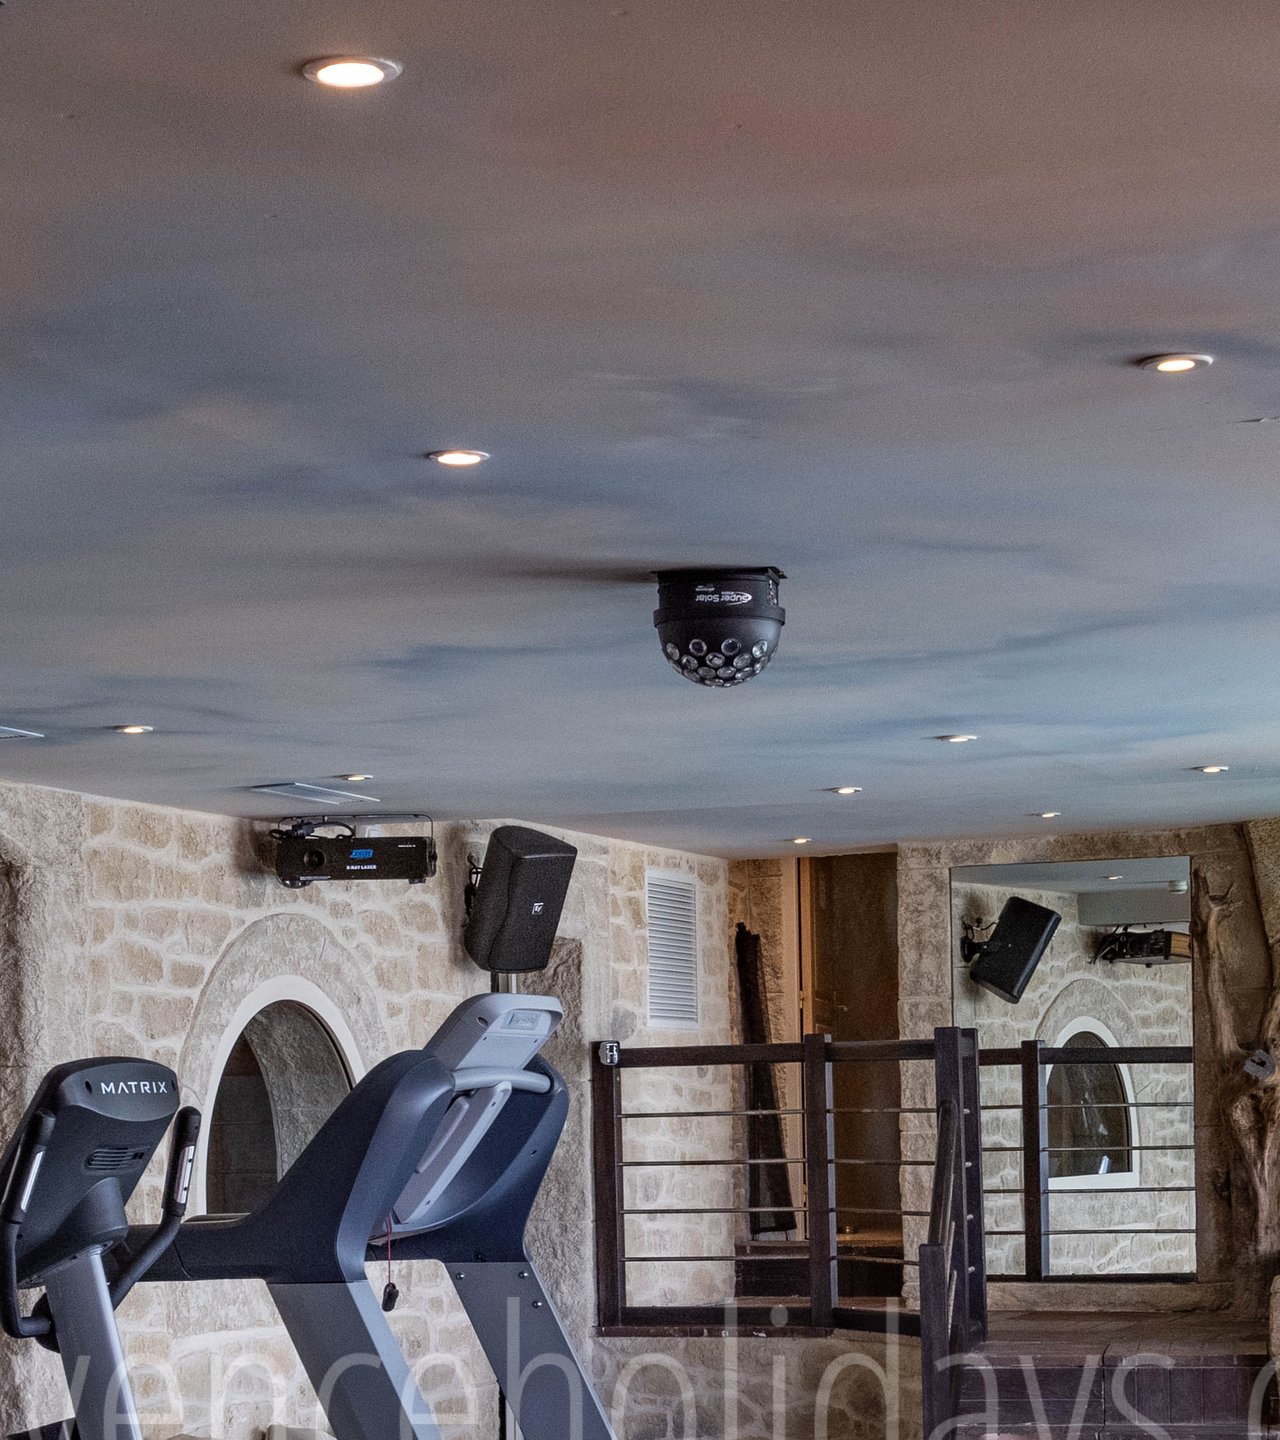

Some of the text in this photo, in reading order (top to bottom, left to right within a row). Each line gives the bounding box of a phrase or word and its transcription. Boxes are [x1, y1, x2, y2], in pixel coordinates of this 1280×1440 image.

[695, 593, 748, 604] Super Solar
[100, 1081, 168, 1094] MATRIX
